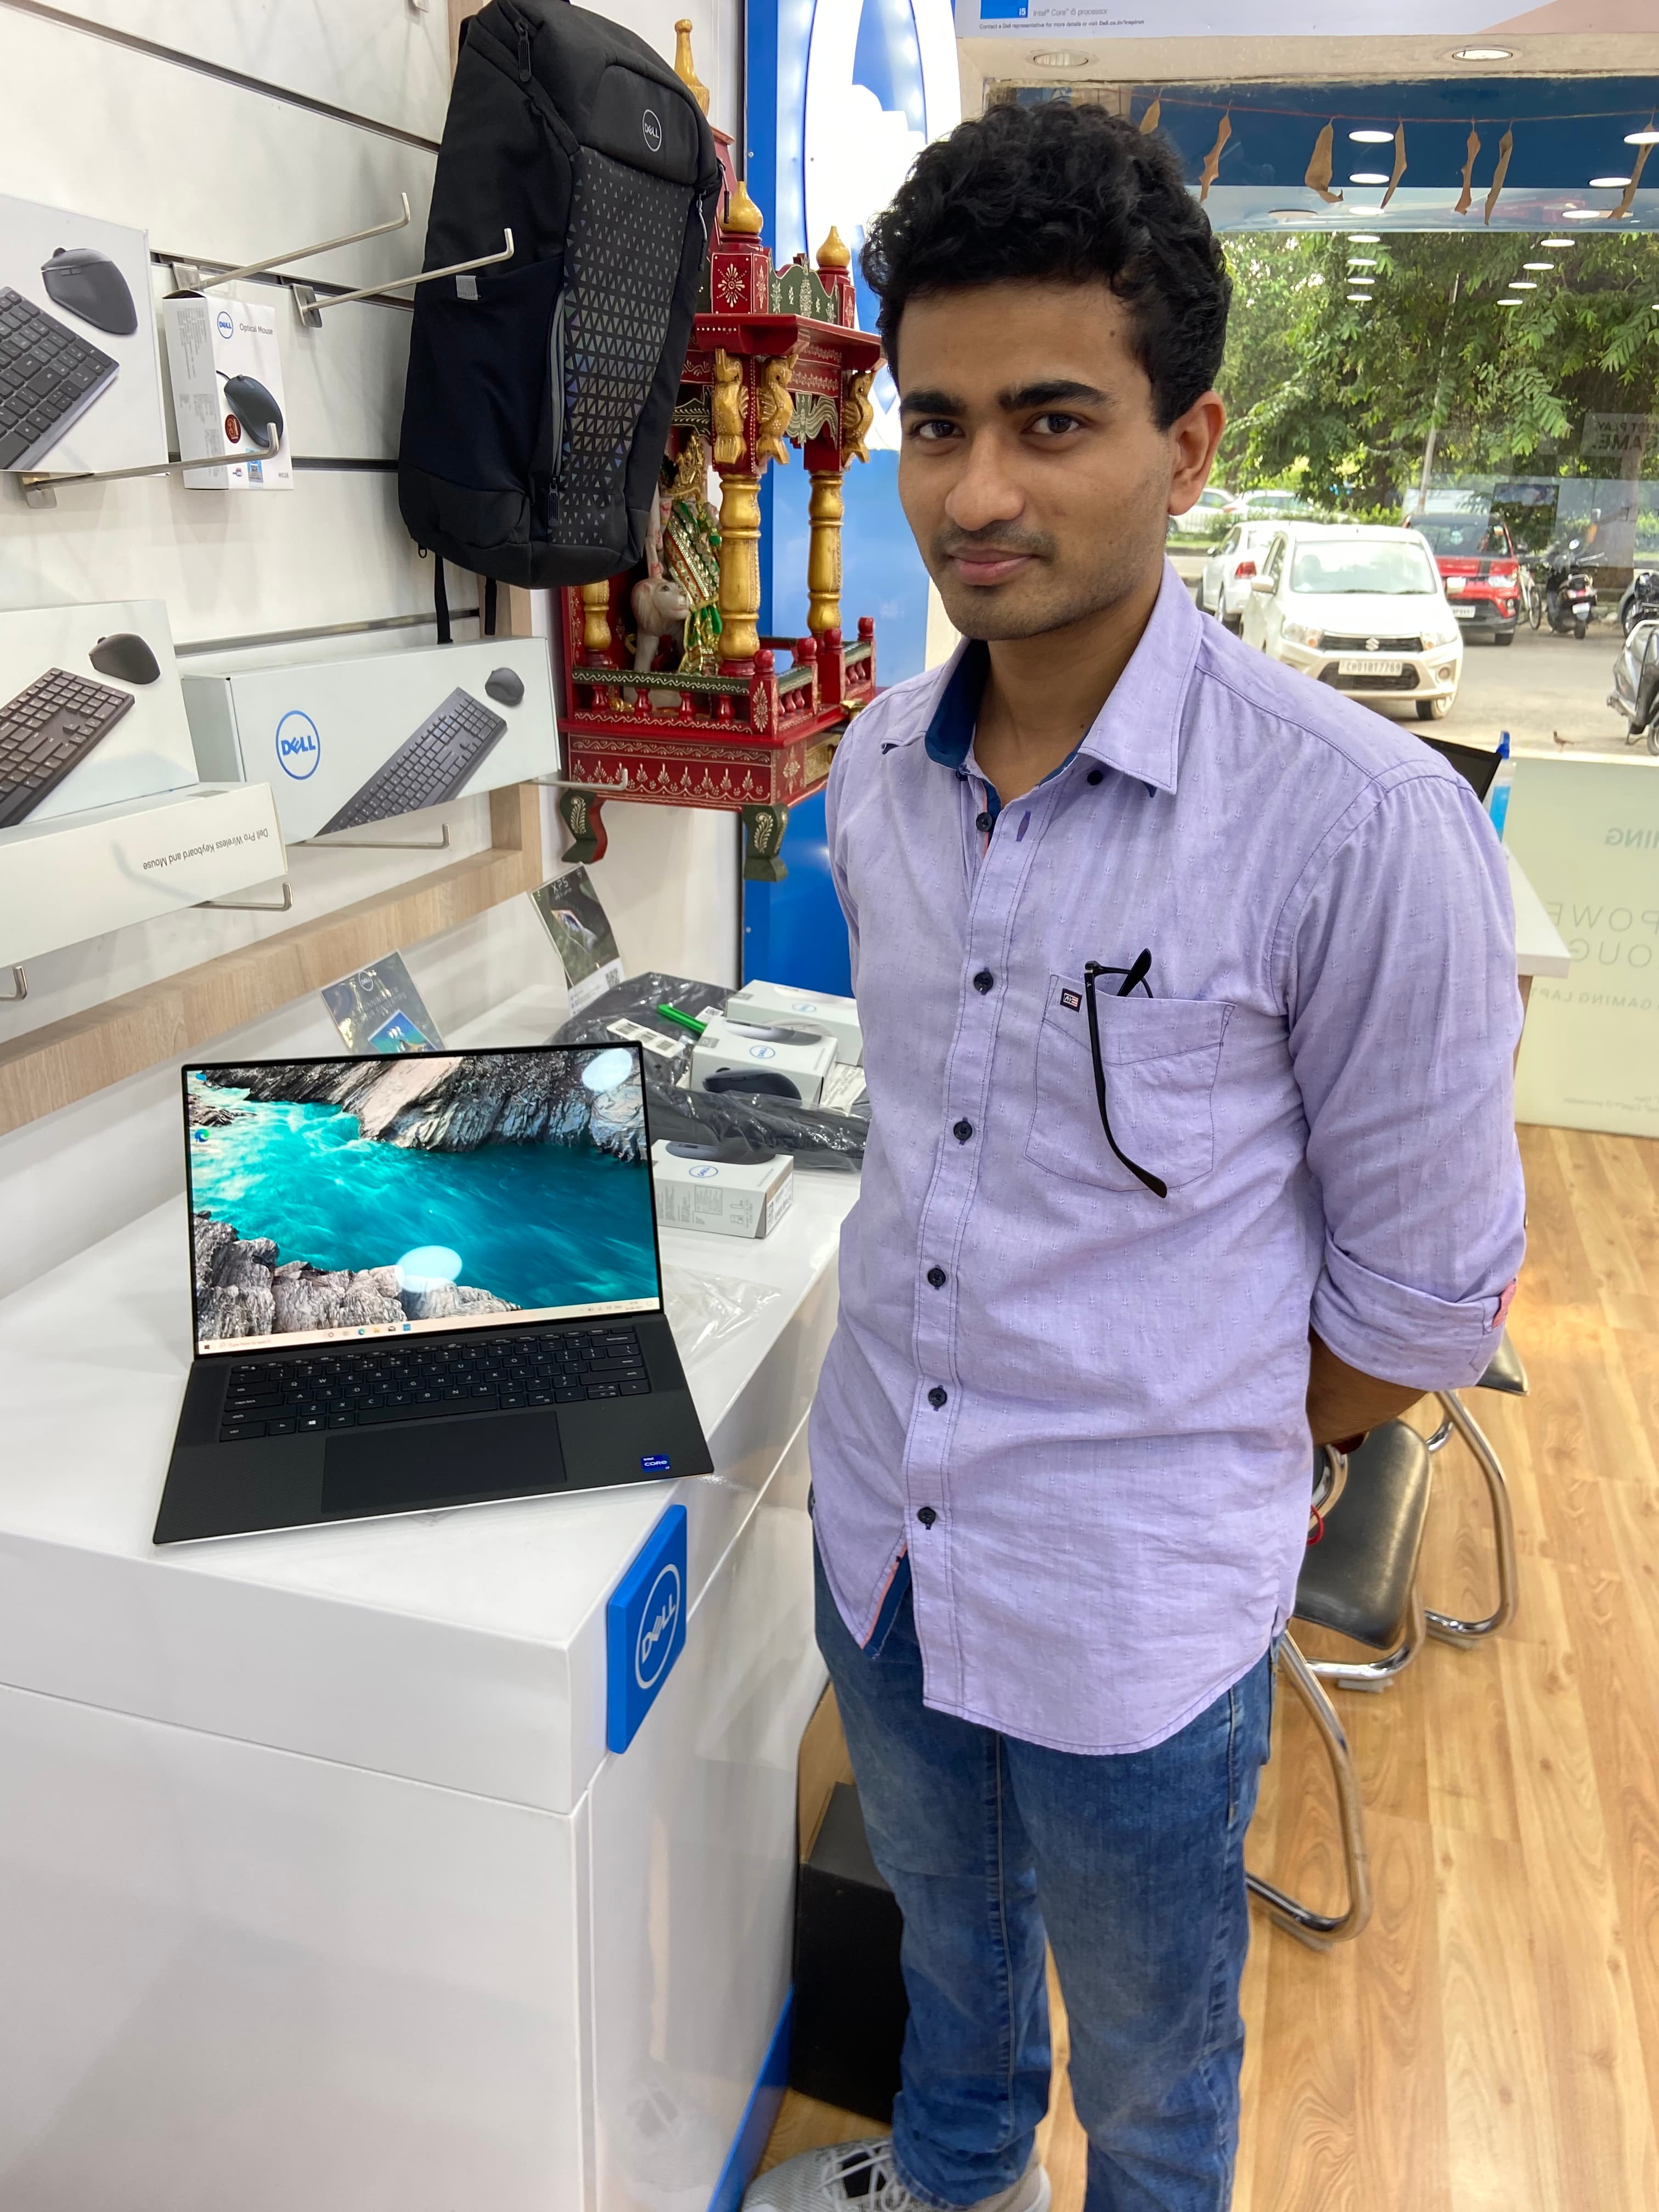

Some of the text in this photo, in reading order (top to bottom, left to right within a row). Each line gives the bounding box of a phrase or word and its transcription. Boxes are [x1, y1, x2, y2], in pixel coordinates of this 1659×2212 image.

[645, 122, 659, 139] DELL
[240, 323, 273, 335] Optical Mouse
[281, 735, 316, 756] DELL
[143, 828, 268, 870] Dell Pro Wireless Keyboard and Mouse
[551, 877, 568, 894] XPS
[758, 1046, 768, 1057] DELL
[697, 1167, 711, 1176] DELL
[641, 1594, 676, 1664] DELL
